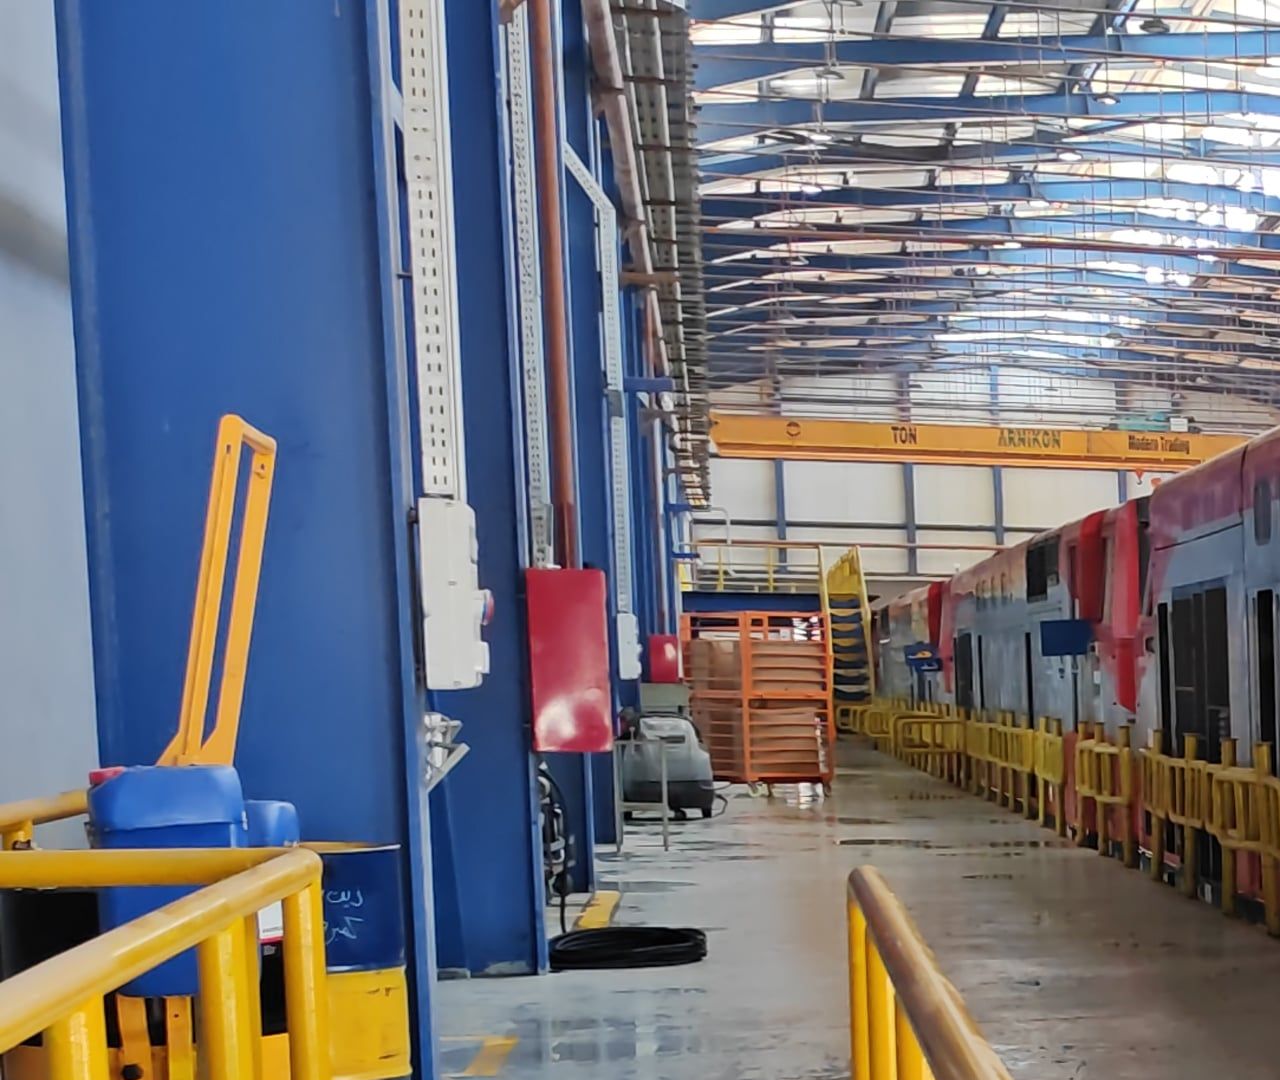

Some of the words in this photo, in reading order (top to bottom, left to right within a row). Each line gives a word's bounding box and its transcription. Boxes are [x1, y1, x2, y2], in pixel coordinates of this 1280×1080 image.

[891, 427, 917, 445] TON
[998, 429, 1061, 449] ARNIKON
[1128, 435, 1158, 452] Modern
[1160, 436, 1190, 455] Trading
